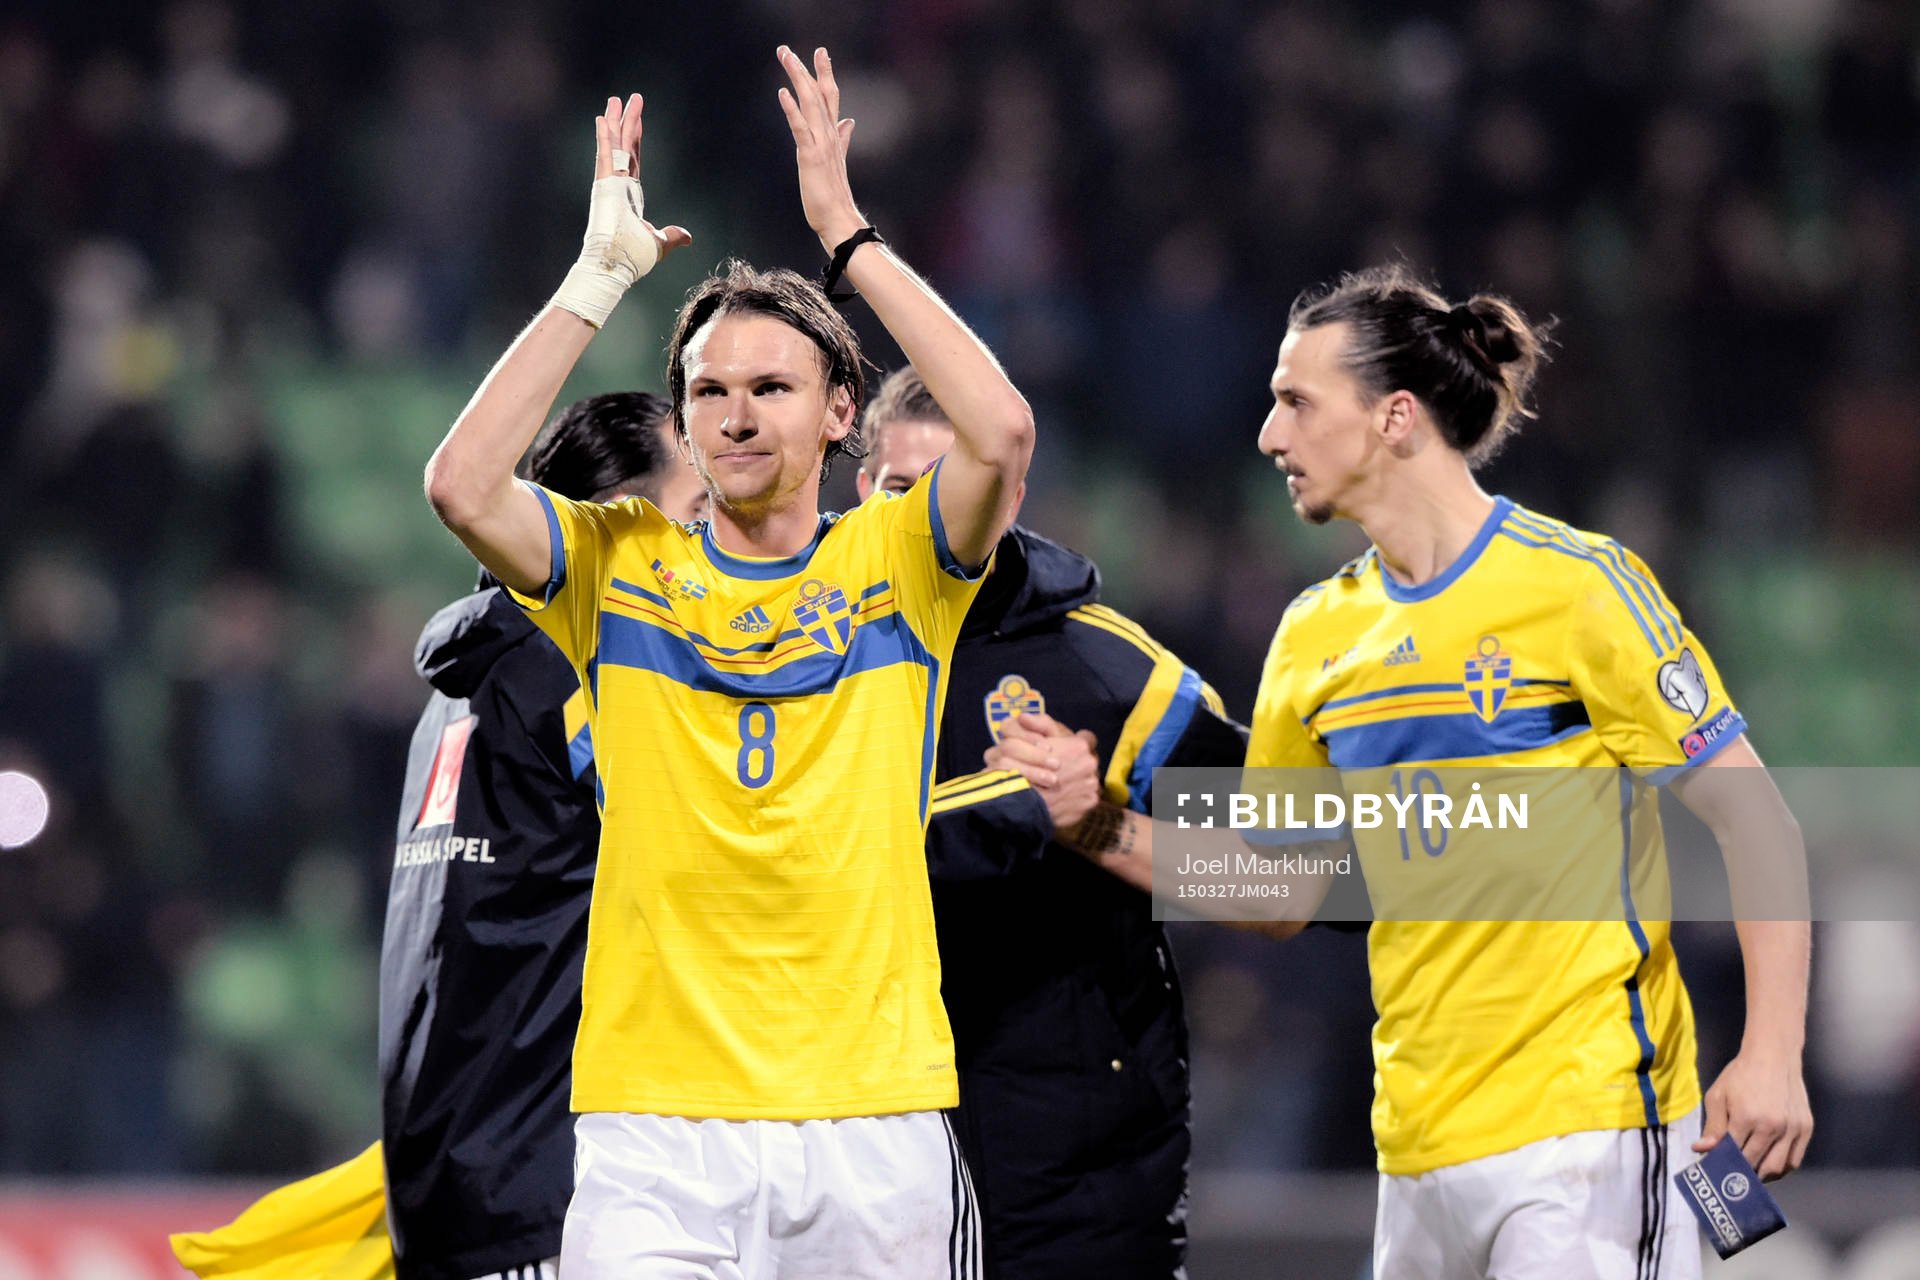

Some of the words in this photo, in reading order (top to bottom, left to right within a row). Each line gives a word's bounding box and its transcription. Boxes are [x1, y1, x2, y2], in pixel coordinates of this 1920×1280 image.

[737, 701, 776, 789] 8
[1390, 768, 1449, 861] 10
[1693, 1178, 1713, 1201] TO
[1704, 1196, 1741, 1246] RACISM
